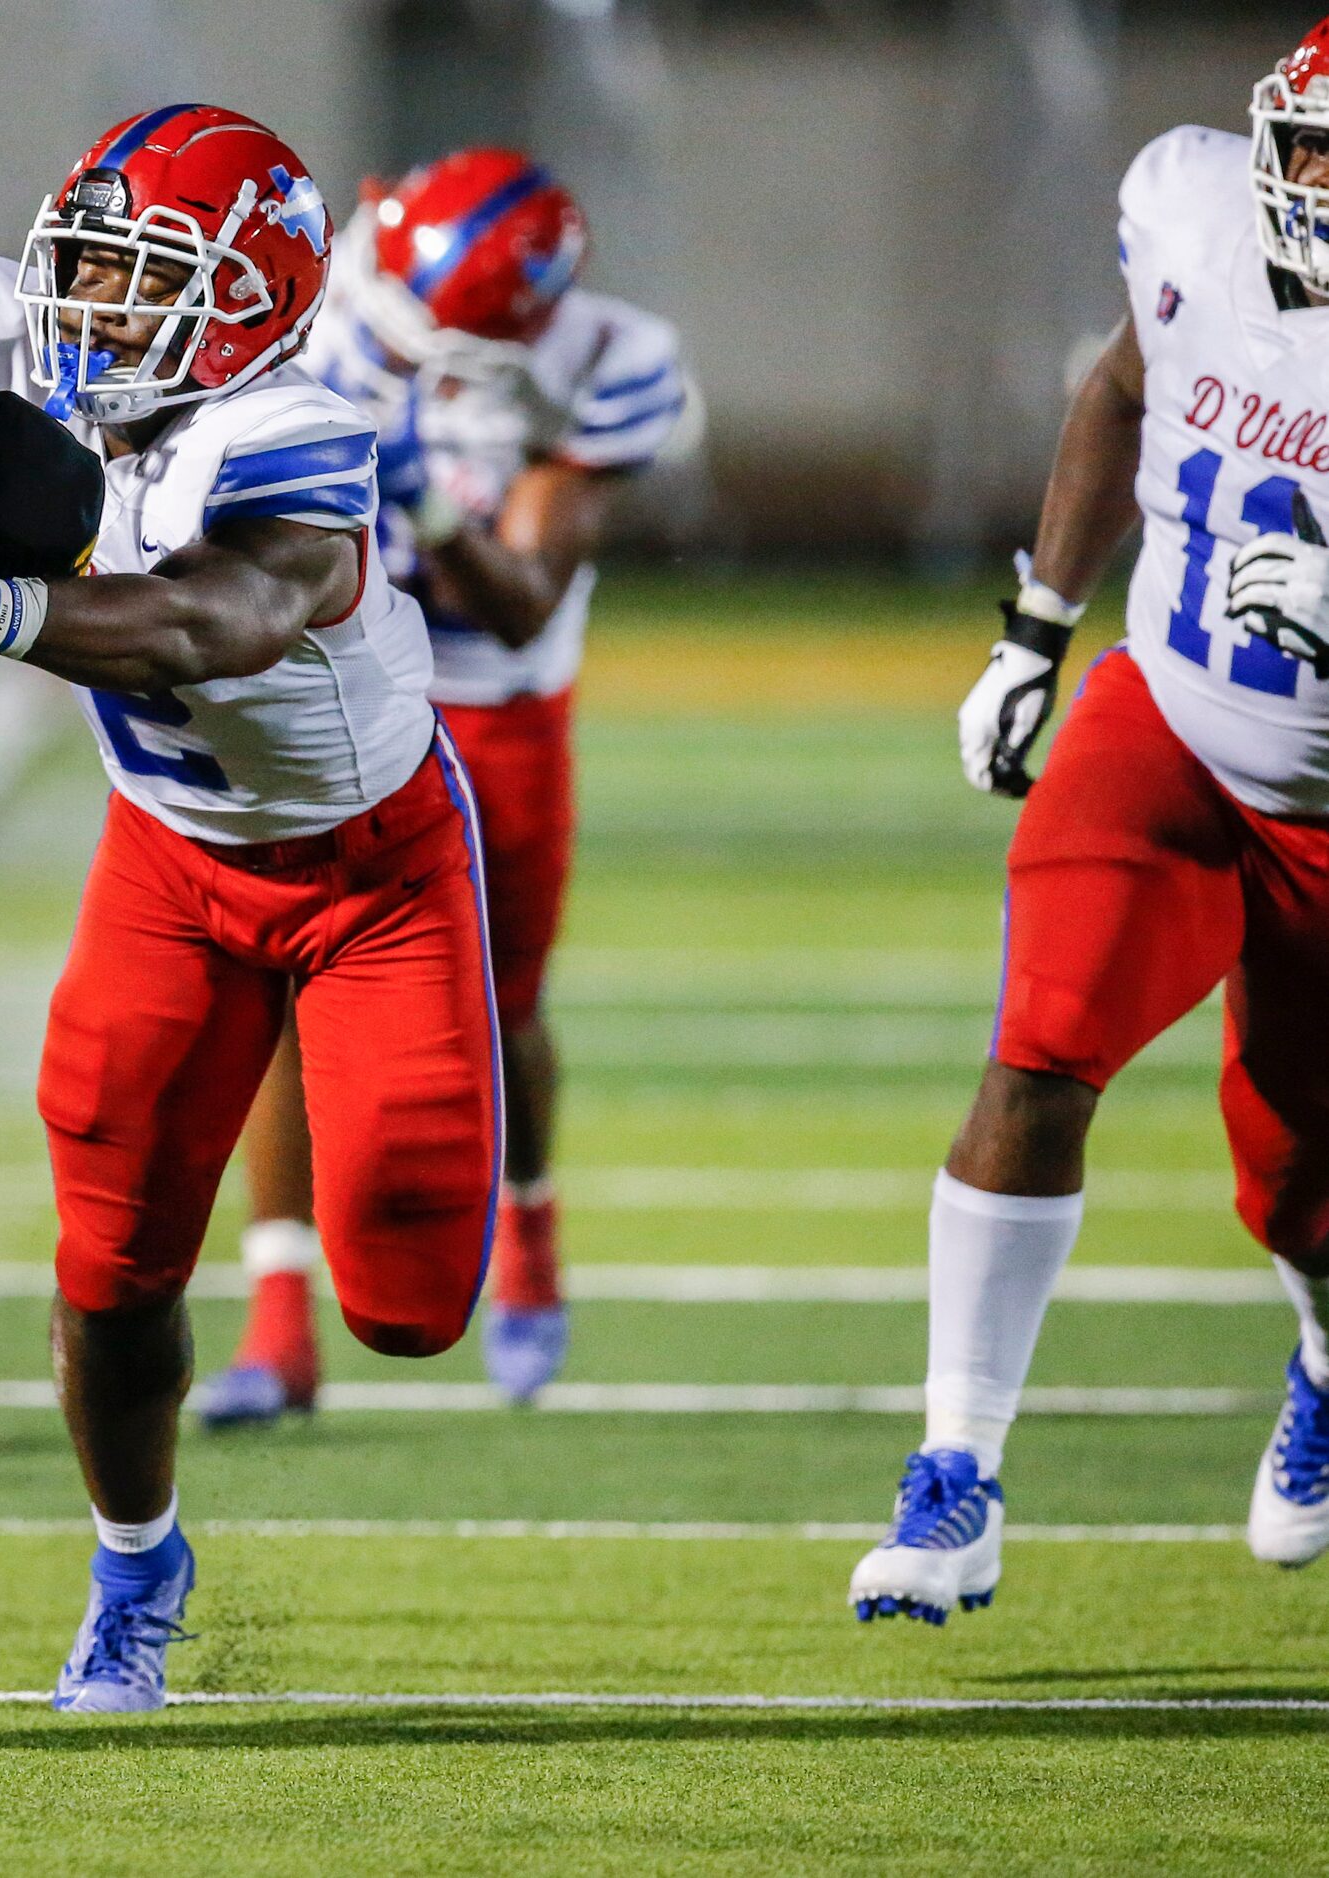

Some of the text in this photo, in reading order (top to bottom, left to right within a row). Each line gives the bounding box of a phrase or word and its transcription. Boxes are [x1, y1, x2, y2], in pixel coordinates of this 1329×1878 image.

[1185, 375, 1329, 473] D'Ville
[1167, 447, 1302, 698] 11
[0, 603, 8, 624] FIND
[12, 612, 20, 630] WAY
